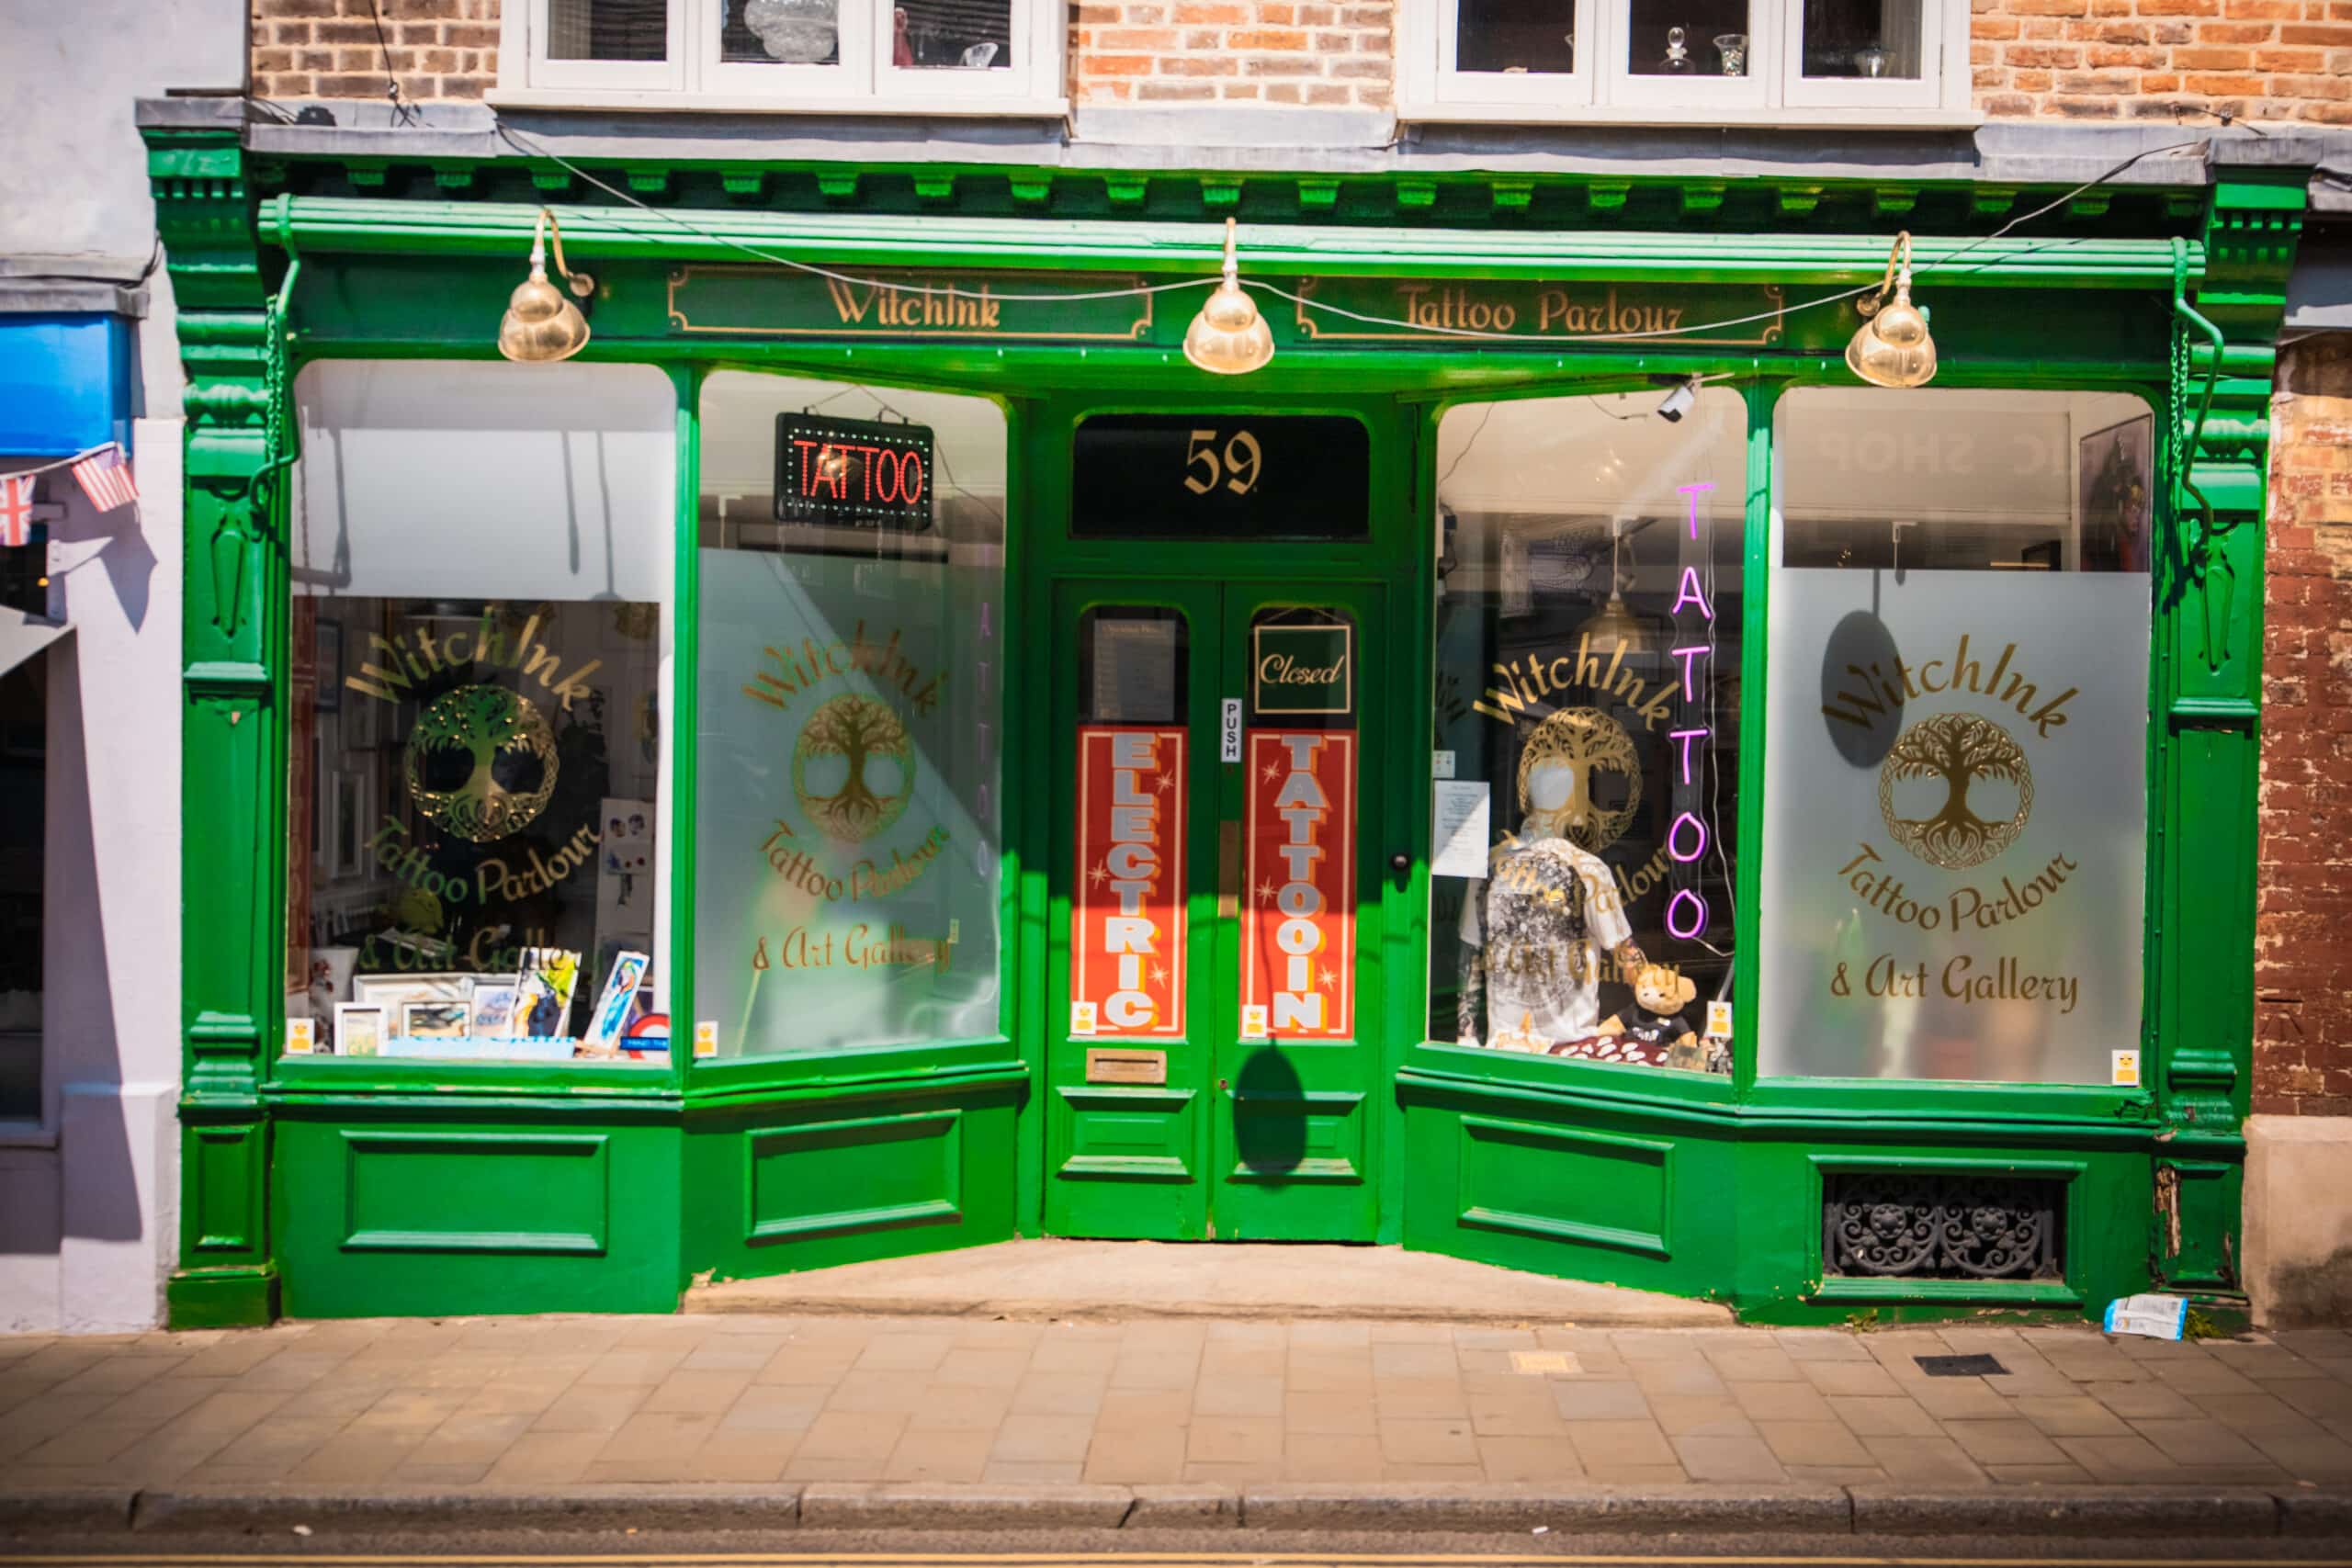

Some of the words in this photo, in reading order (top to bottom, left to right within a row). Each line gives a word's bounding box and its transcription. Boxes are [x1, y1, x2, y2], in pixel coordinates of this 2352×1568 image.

[826, 276, 1001, 328] WitchInk
[1397, 285, 1517, 331] Tattoo
[1538, 288, 1683, 333] Parlour
[793, 439, 923, 506] TATTOO
[1183, 428, 1262, 497] 59
[345, 605, 604, 712] WitchInk
[740, 619, 950, 721] WitchInk
[1259, 652, 1344, 685] Closed
[1473, 632, 1682, 731] WitchInk
[1821, 633, 2081, 740] WitchInk
[1225, 703, 1238, 758] PUSH
[1667, 482, 1716, 940] TATTOO
[365, 815, 468, 903] Tattoo
[476, 823, 605, 905] Parlour
[760, 818, 844, 902] Tattoo
[851, 823, 951, 903] Parlour
[1104, 732, 1161, 1028] ELECTRIC
[1838, 841, 1942, 931] Tattoo
[1948, 852, 2079, 933] Parlour
[359, 933, 380, 971] &
[752, 935, 771, 972] &
[783, 926, 833, 969] Art
[1830, 961, 1852, 998] &
[1865, 953, 1929, 998] Art
[1941, 954, 2080, 1015] Gallery
